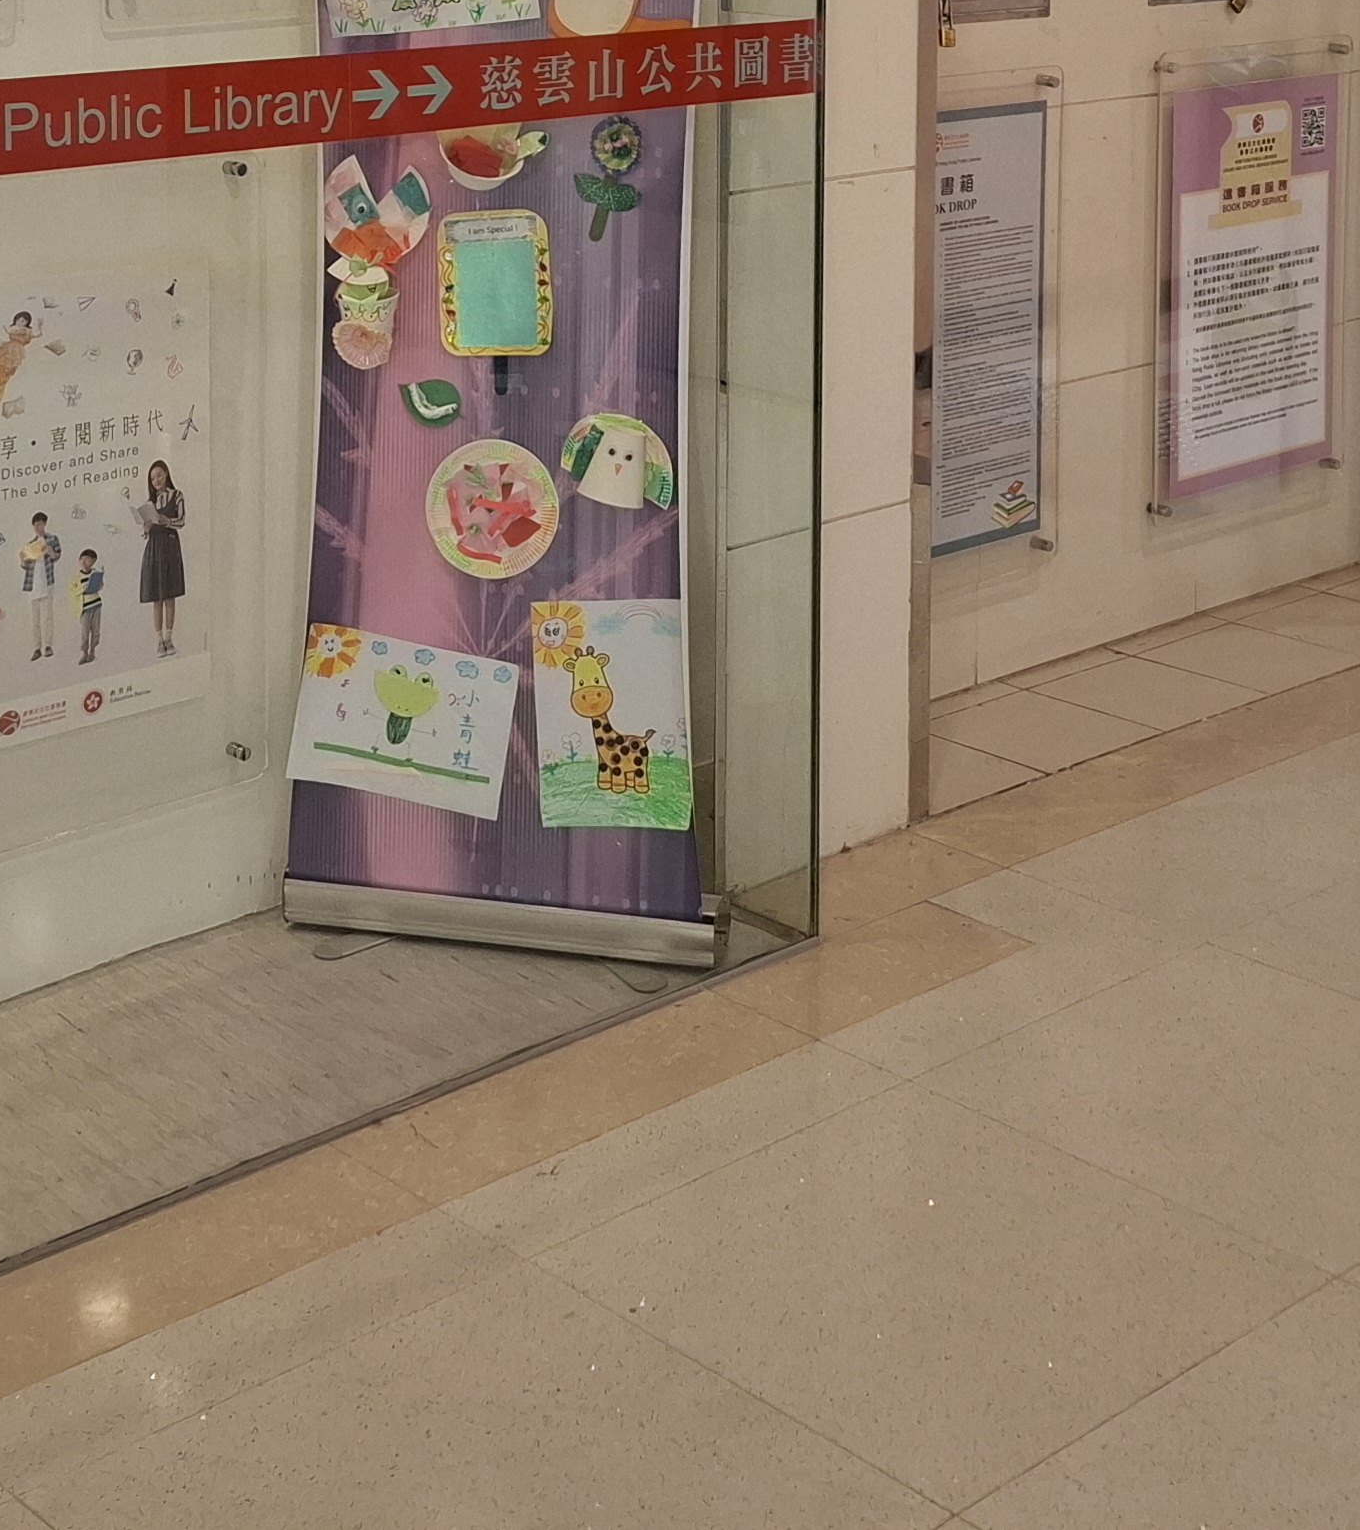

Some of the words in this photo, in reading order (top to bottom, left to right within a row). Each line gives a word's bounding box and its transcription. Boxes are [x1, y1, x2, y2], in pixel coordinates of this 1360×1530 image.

[2, 92, 165, 152] Public
[182, 82, 345, 136] Library
[948, 198, 978, 214] DROP
[1222, 203, 1241, 213] BOOK
[1242, 198, 1260, 210] DROP
[1261, 193, 1289, 206] SERVICE
[486, 224, 514, 234] Special
[1, 458, 64, 481] Discover
[68, 452, 95, 468] and
[99, 444, 140, 463] Share
[0, 486, 28, 501] The
[33, 480, 59, 496] Joy
[63, 474, 78, 488] of
[82, 464, 140, 485] Reading
